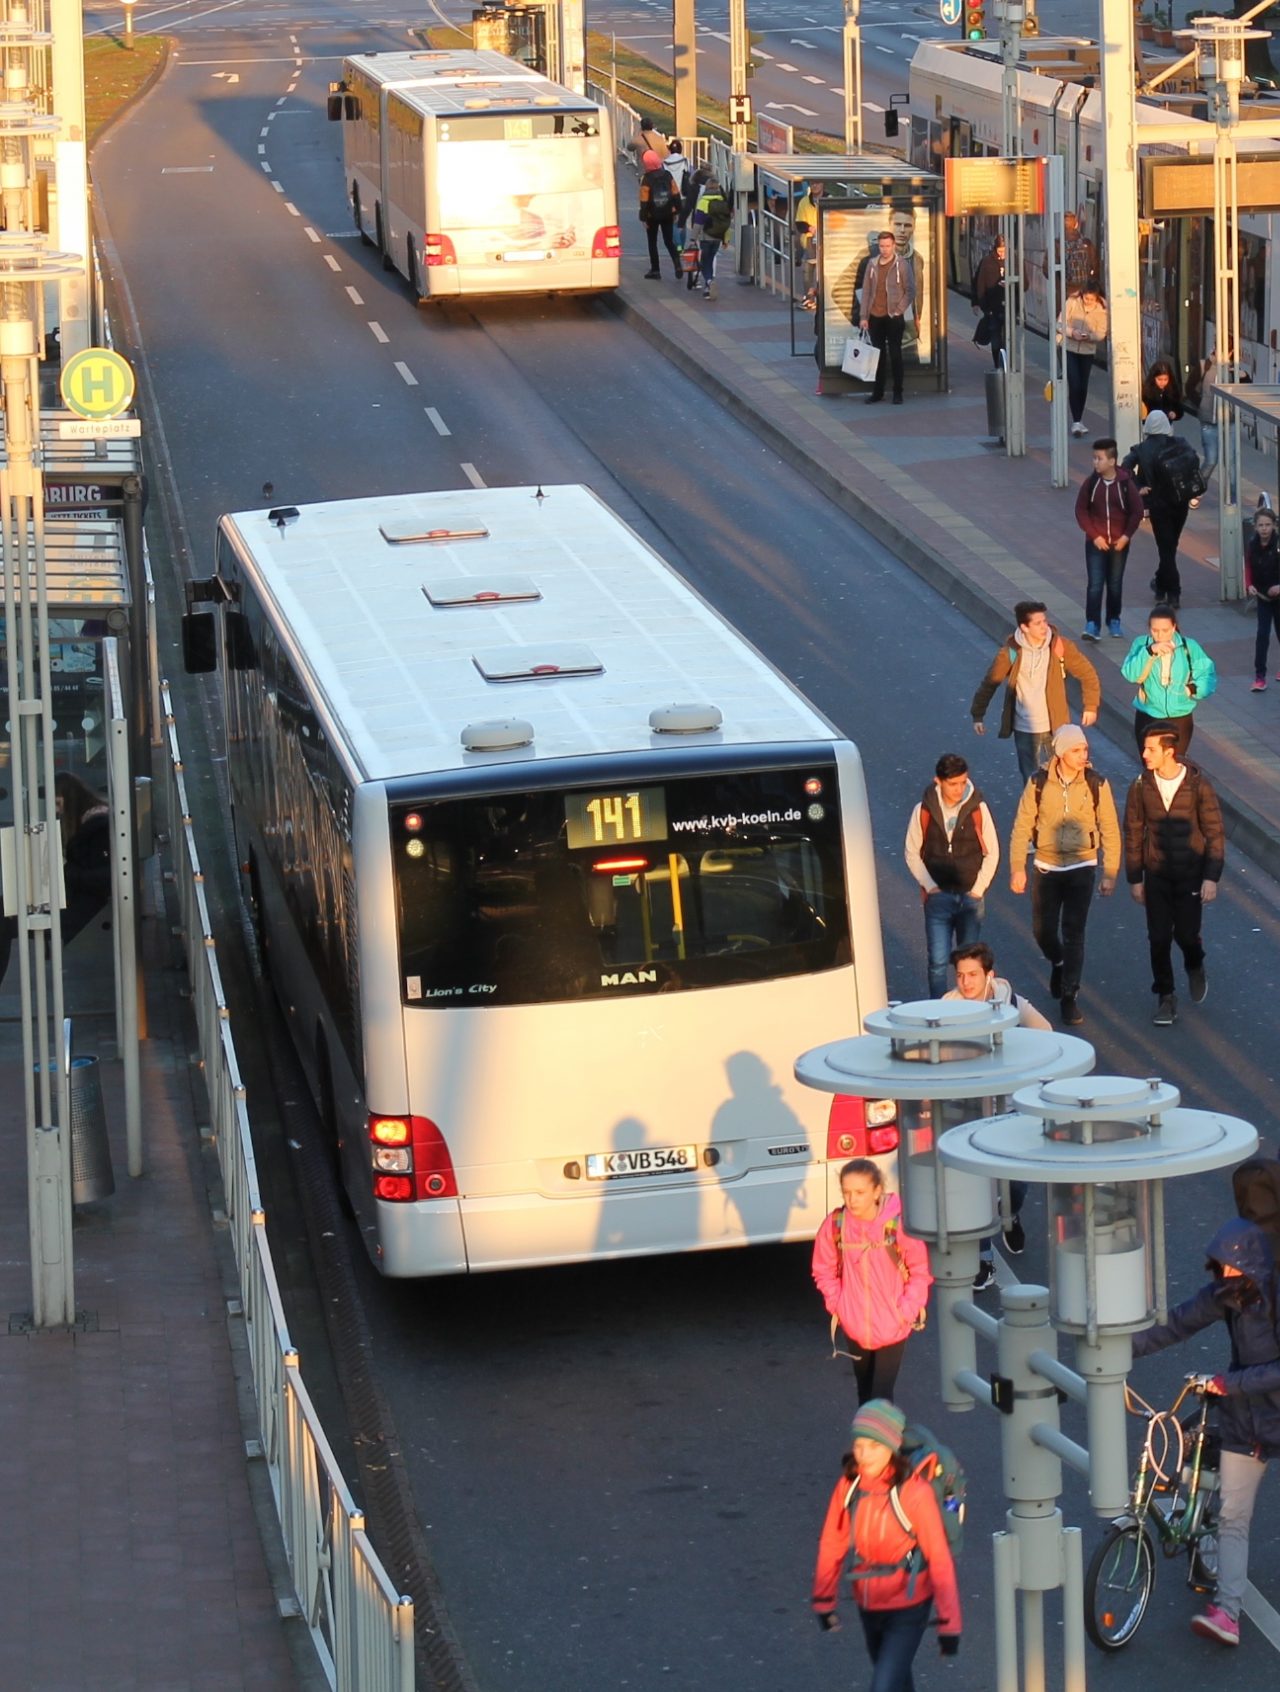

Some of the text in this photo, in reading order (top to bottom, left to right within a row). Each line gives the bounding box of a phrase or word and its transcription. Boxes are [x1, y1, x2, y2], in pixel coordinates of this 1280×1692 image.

[730, 97, 751, 123] H
[80, 366, 114, 403] H
[69, 424, 131, 435] Warteplatz
[586, 794, 642, 842] 141
[672, 807, 803, 833] www.kvb-koeln.de
[425, 983, 498, 998] Lion's City
[600, 969, 657, 987] MAN
[603, 1156, 615, 1173] K
[627, 1152, 651, 1171] VB
[654, 1149, 689, 1168] 548
